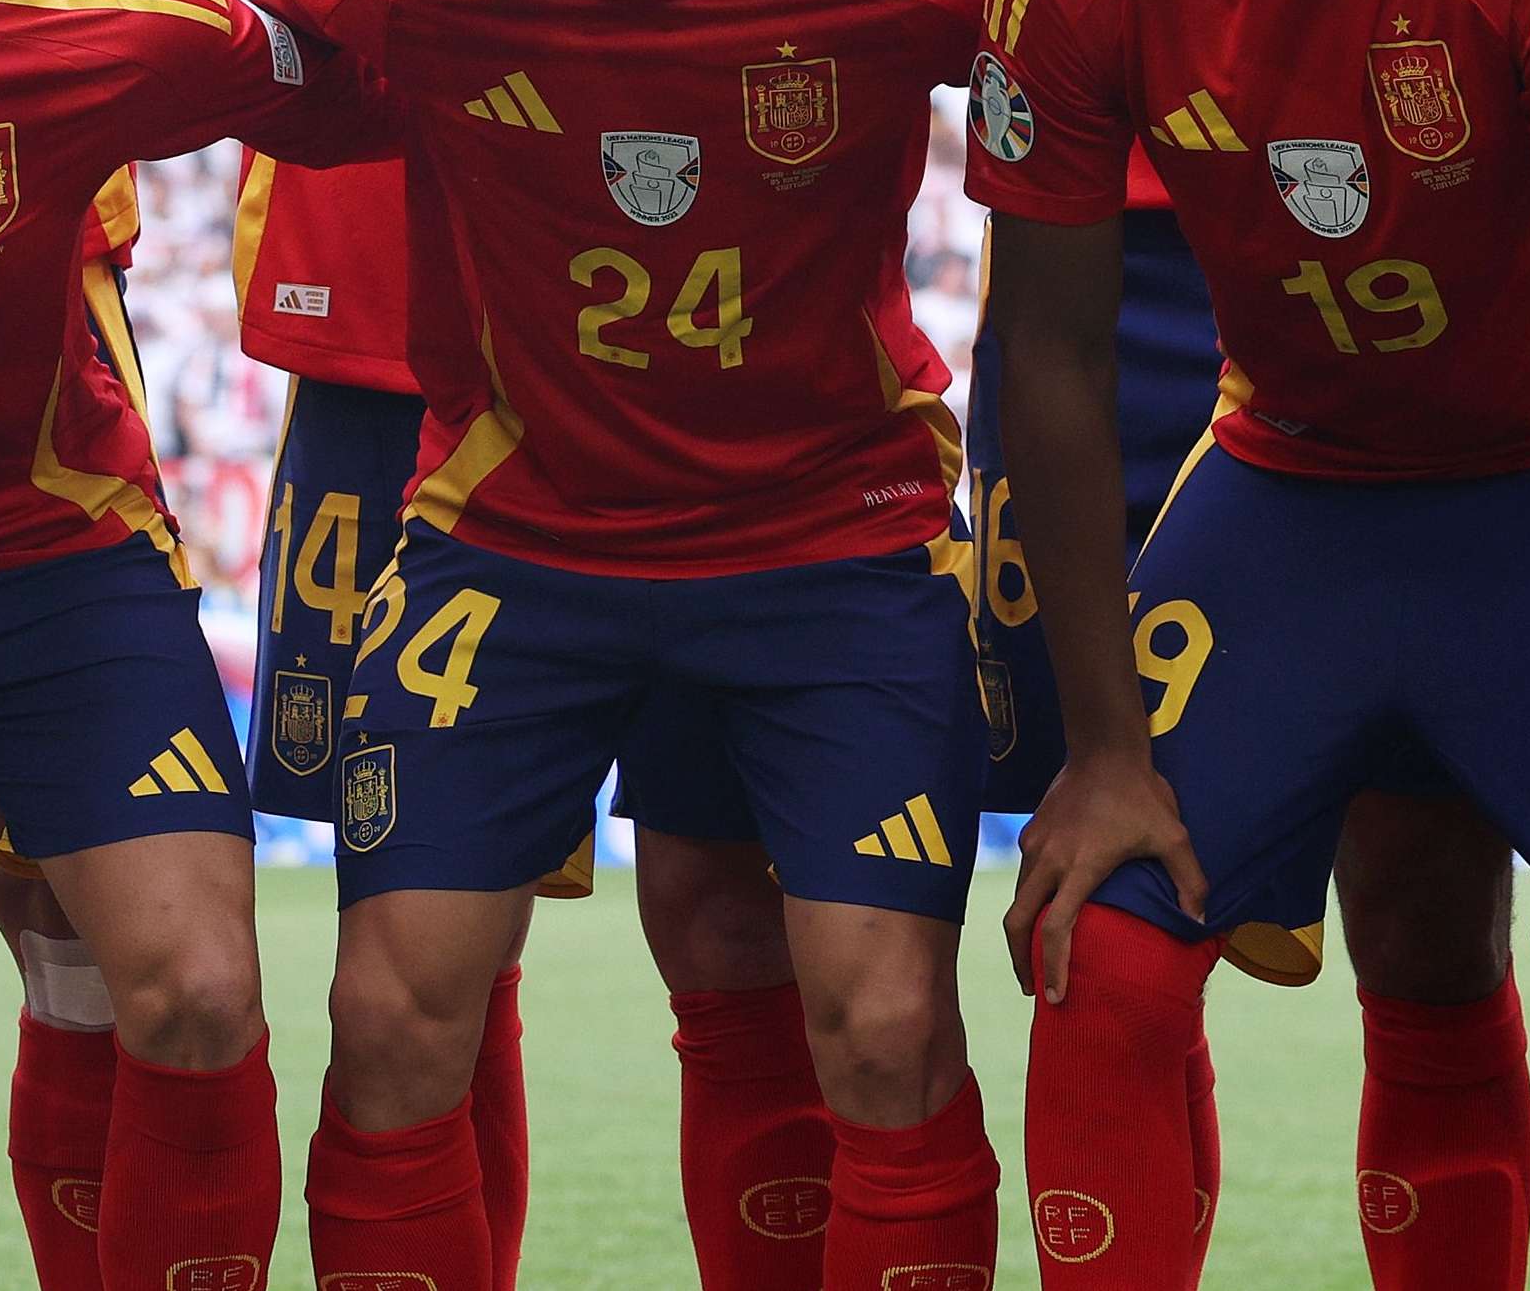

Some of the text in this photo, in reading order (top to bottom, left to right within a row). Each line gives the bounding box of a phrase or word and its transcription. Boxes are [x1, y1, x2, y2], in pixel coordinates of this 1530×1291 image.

[663, 136, 693, 146] LEAGUE
[1326, 143, 1356, 152] LEAGUE
[569, 247, 753, 369] 24
[1281, 259, 1449, 355] 19
[271, 482, 368, 646] 14
[342, 575, 502, 729] 24
[1126, 591, 1215, 738] 9
